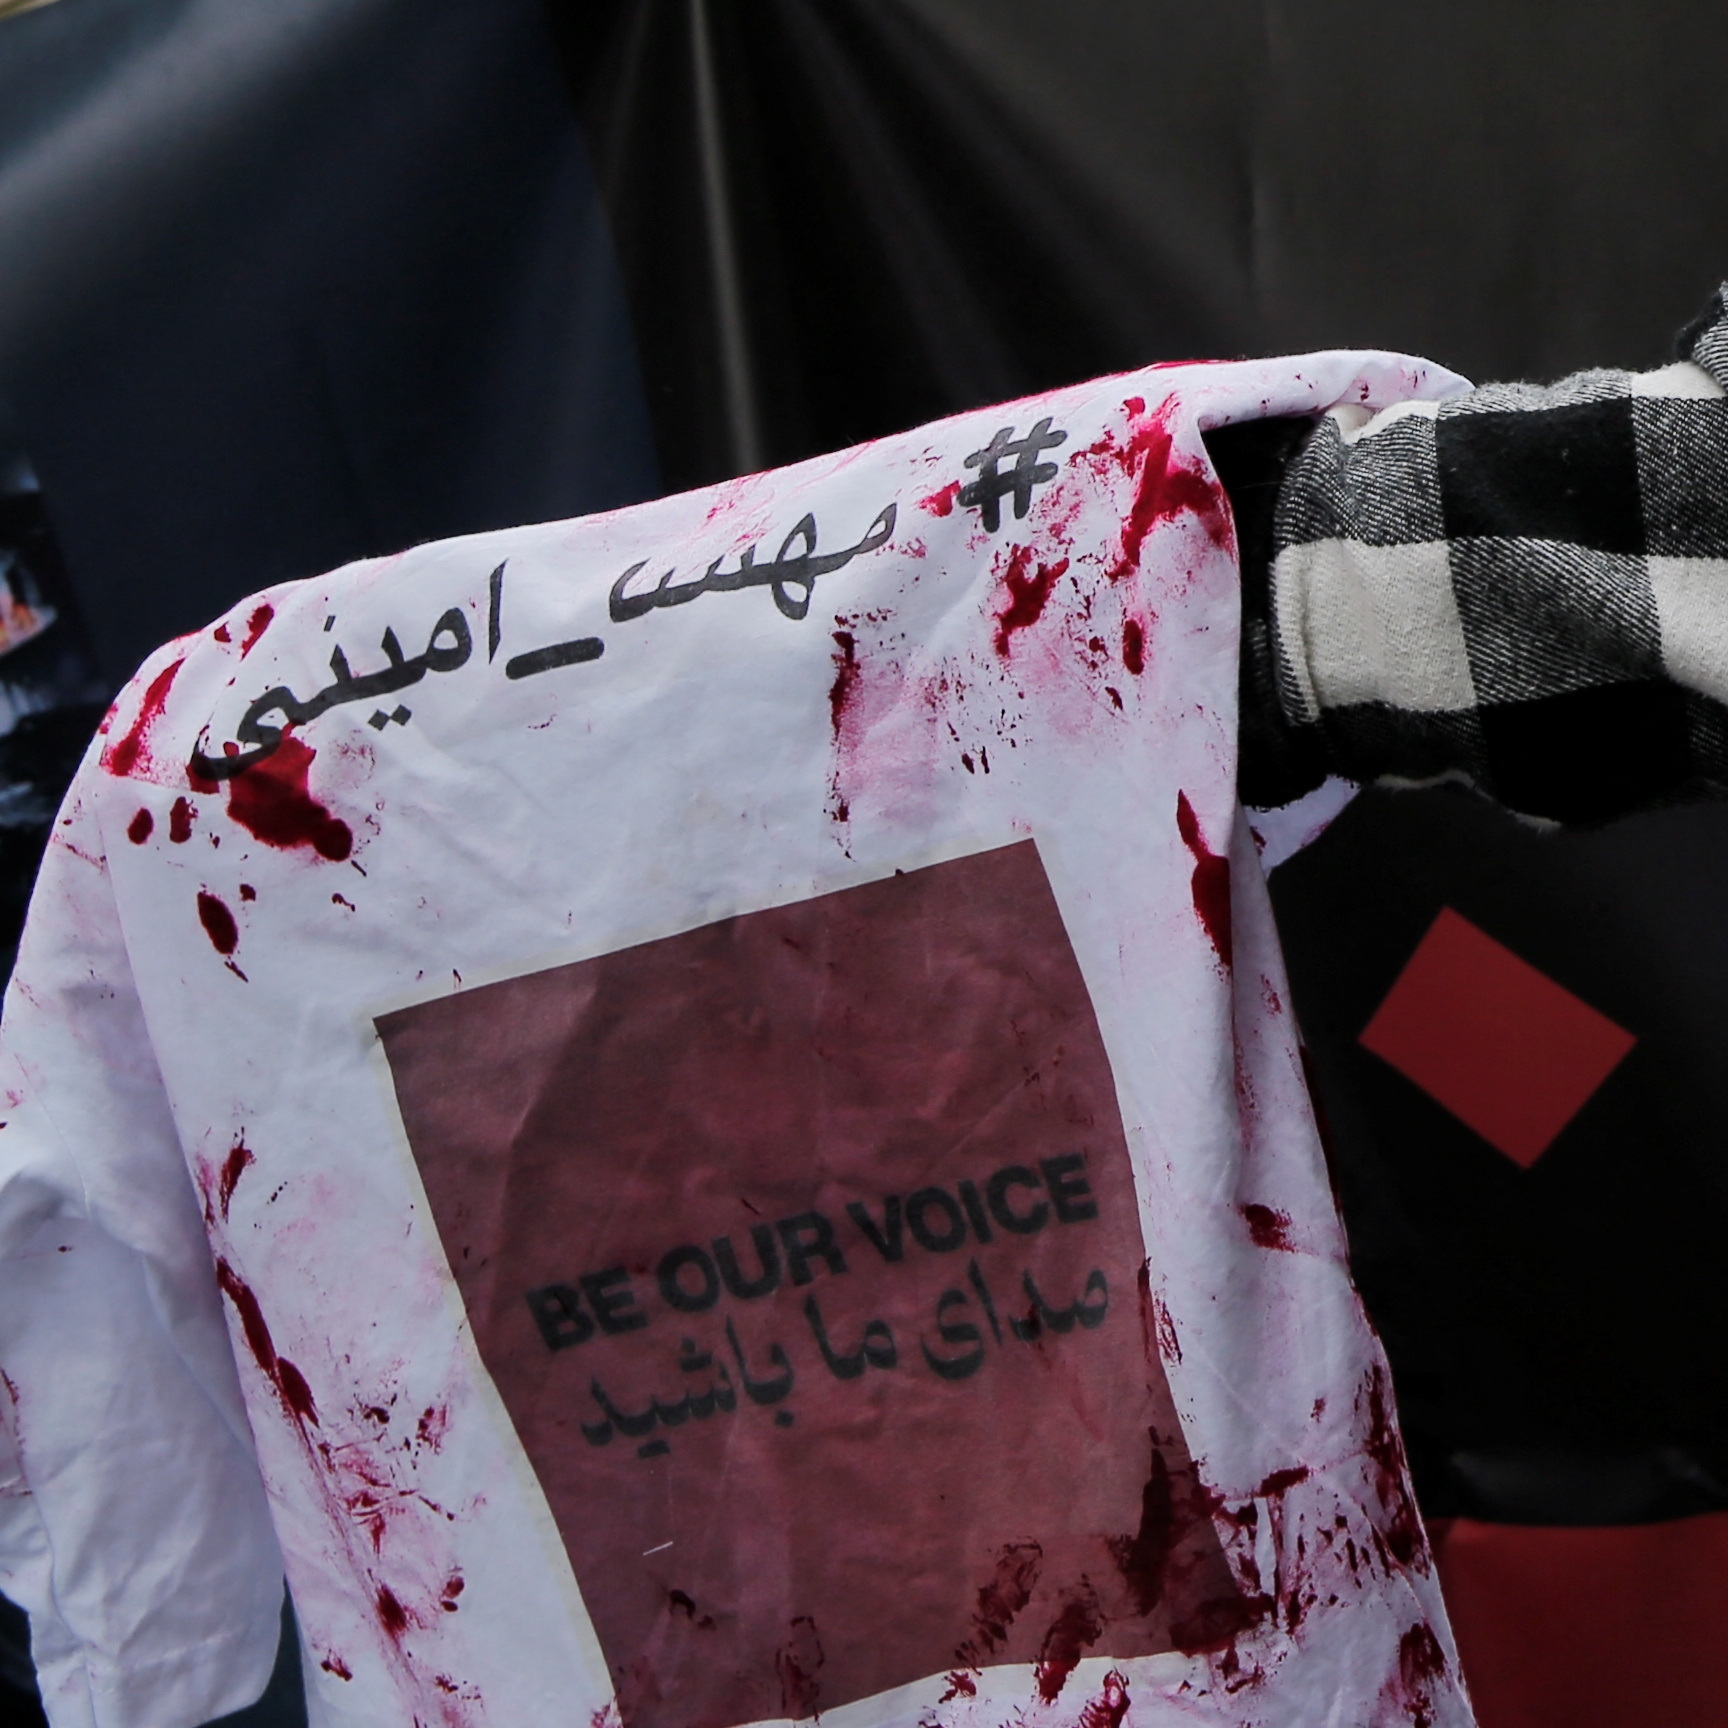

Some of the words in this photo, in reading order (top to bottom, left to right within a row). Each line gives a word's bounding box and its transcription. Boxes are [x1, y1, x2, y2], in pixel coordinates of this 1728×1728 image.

[526, 1265, 649, 1353] BE
[659, 1212, 848, 1316] OUR
[846, 1152, 1100, 1263] VOICE
[918, 1256, 1109, 1381] صدای
[581, 1314, 796, 1459] باشید
[805, 1294, 898, 1380] ما
